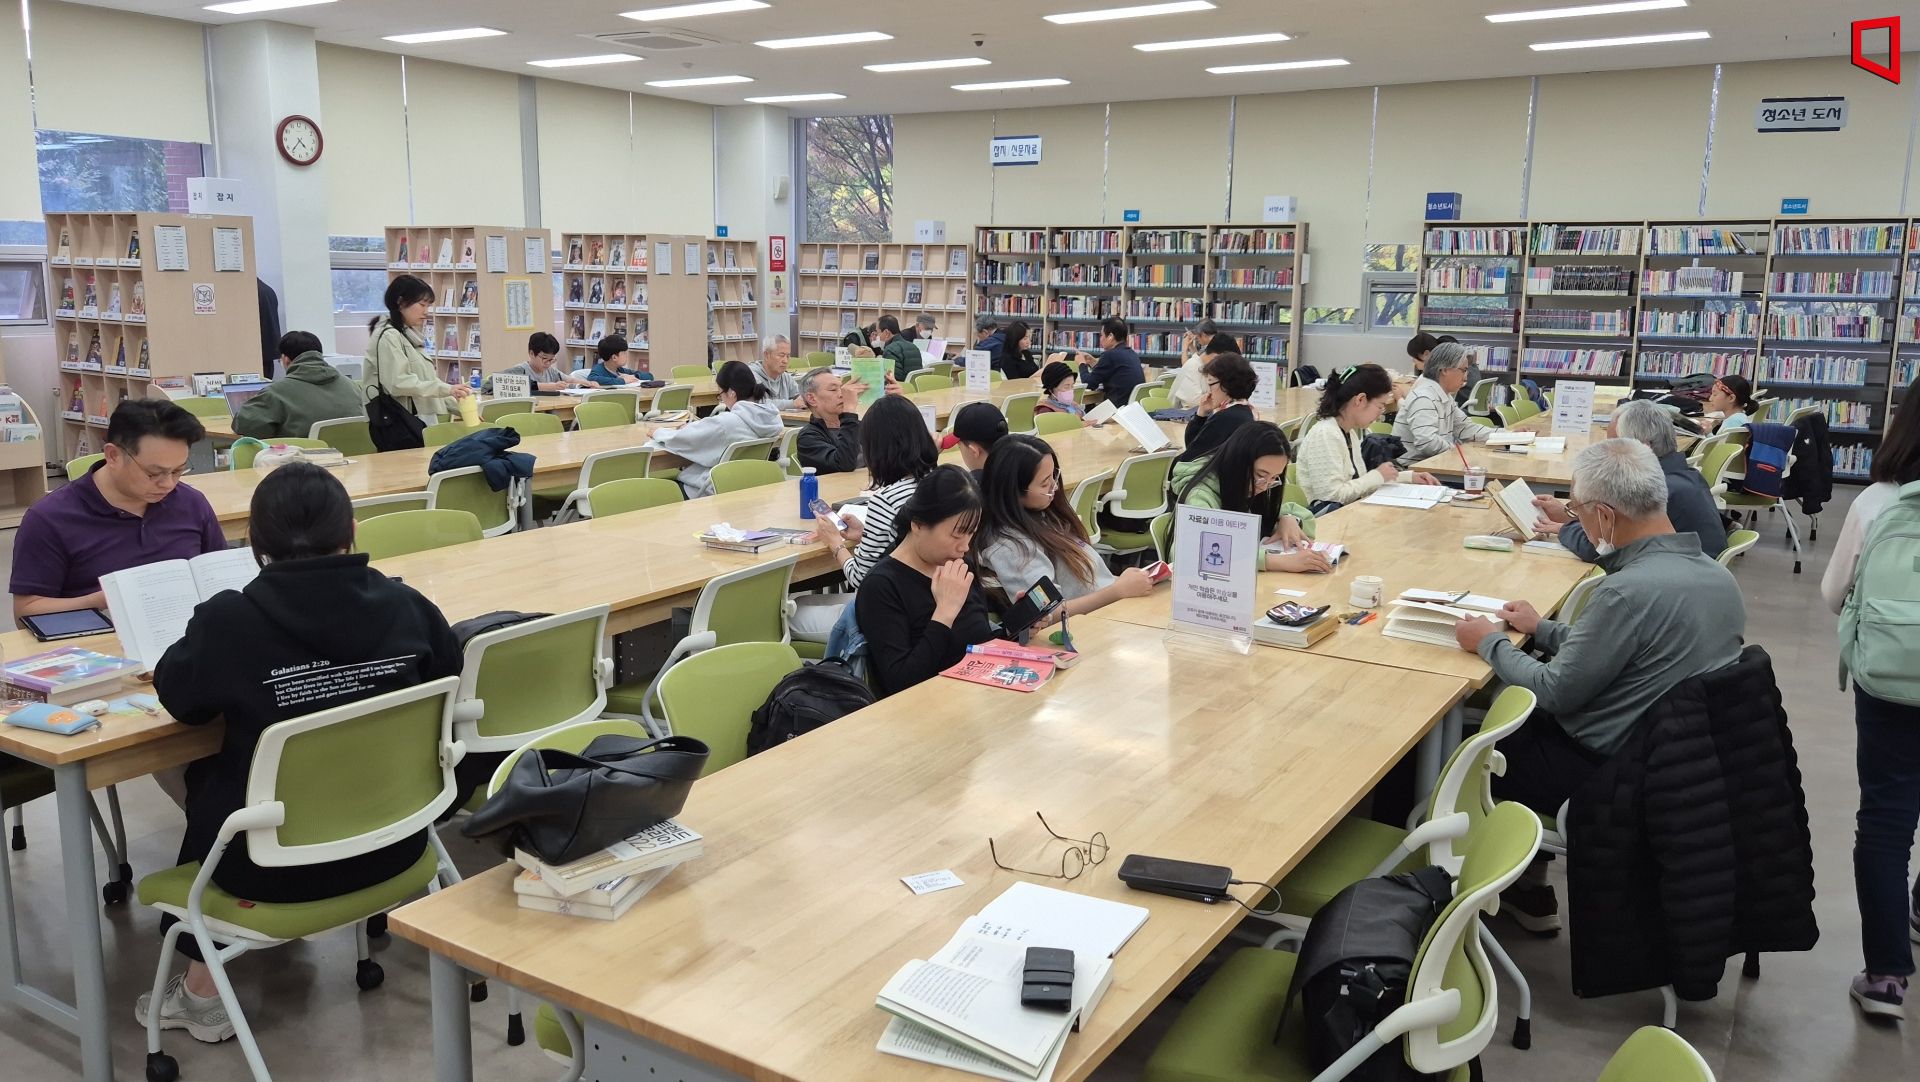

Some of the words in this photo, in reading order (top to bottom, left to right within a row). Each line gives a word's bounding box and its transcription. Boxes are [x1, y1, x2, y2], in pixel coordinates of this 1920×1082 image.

[1762, 108, 1806, 122] 청소년
[1811, 107, 1842, 121] 도서
[994, 145, 1006, 158] 잡지
[1011, 144, 1037, 156] 신문자료
[1188, 514, 1209, 525] 자료실
[1210, 518, 1224, 526] 이용
[1226, 520, 1246, 530] 에티켓
[271, 664, 310, 676] Galatians
[312, 660, 330, 668] 2:20
[623, 833, 657, 852] 022
